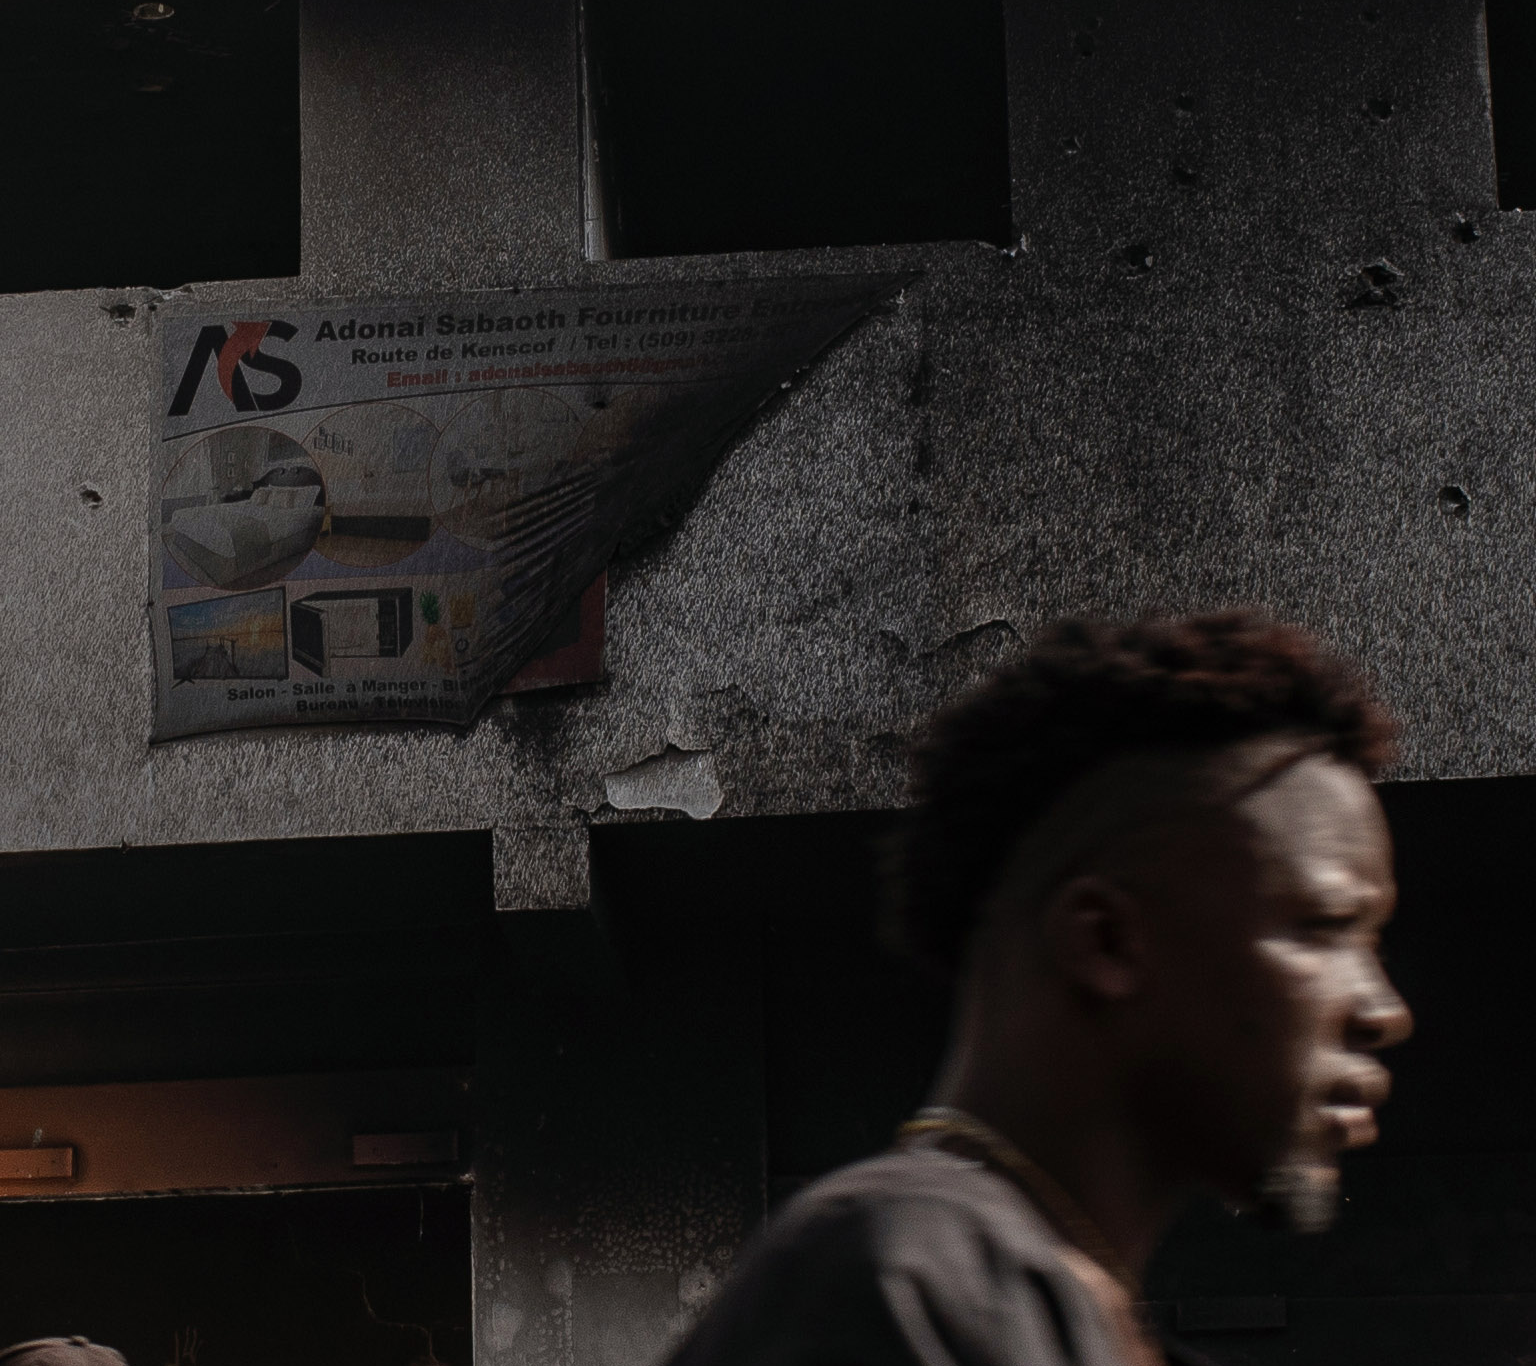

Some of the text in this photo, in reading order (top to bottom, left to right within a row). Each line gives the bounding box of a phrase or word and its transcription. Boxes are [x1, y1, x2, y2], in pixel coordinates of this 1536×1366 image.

[314, 315, 426, 342] Adonai
[435, 309, 566, 335] Sabaoth
[578, 301, 740, 326] Fourniture
[351, 348, 418, 365] Route
[425, 345, 453, 361] de
[461, 337, 556, 359] Kenscof
[584, 333, 618, 351] Tel
[637, 328, 696, 352] (509)
[386, 368, 449, 387] Email
[227, 686, 276, 702] Salon
[291, 682, 336, 696] Salle
[362, 678, 427, 696] Manger
[296, 698, 359, 713] Bureau
